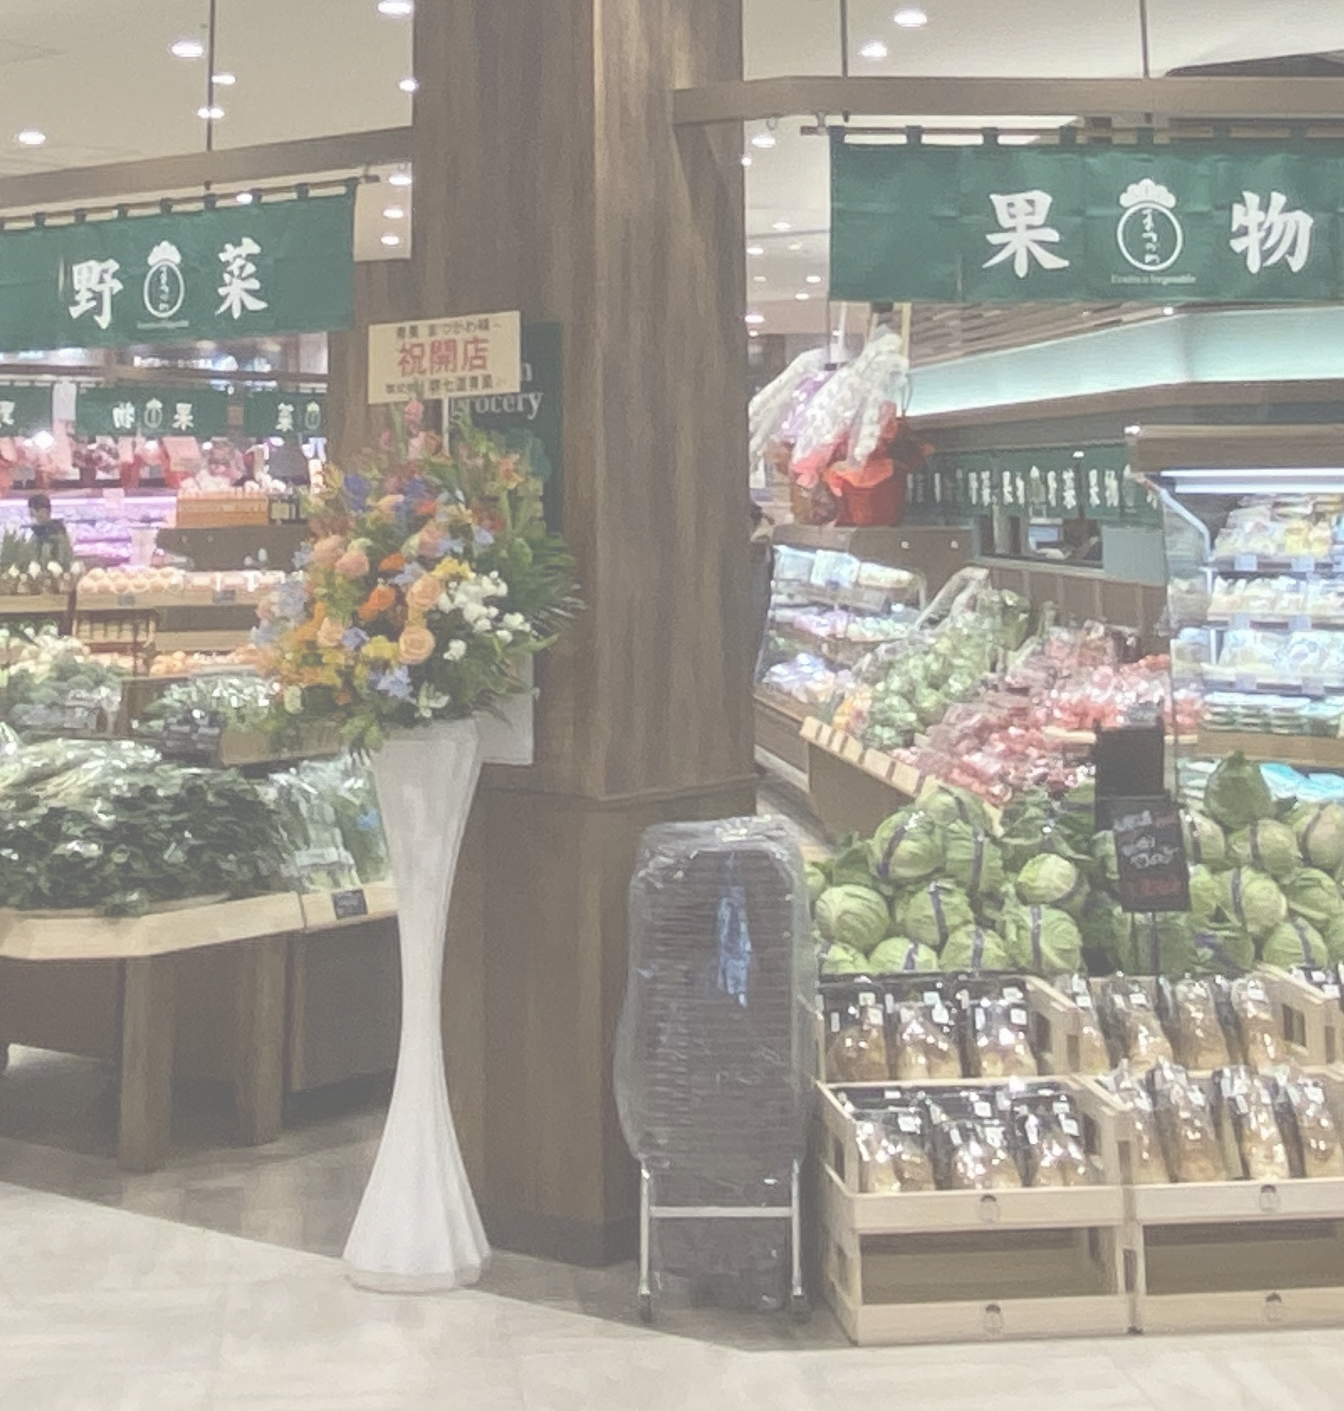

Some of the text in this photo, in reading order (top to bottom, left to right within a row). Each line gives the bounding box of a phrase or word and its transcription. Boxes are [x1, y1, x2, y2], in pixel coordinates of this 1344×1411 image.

[397, 336, 490, 378] 祝開店
[451, 392, 545, 421] ocery
